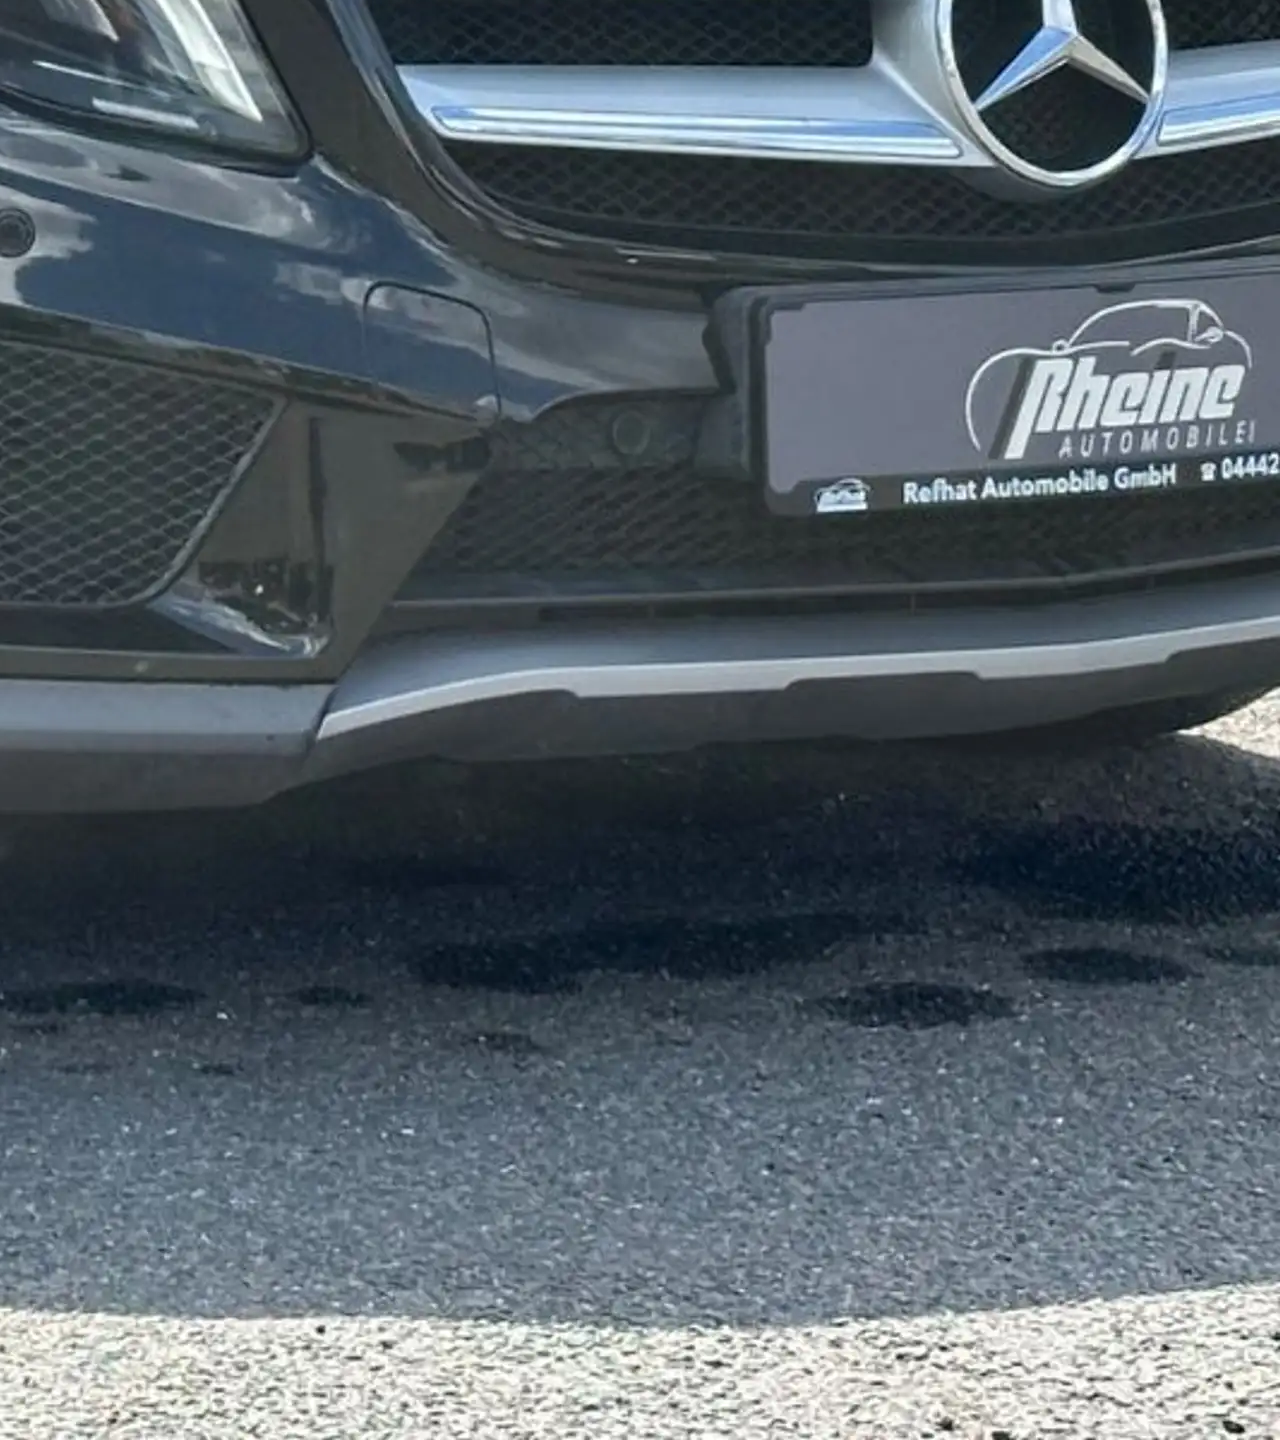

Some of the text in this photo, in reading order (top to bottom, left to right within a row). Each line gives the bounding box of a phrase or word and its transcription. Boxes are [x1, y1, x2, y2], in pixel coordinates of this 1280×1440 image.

[1003, 356, 1246, 460] Rheine
[902, 477, 977, 505] Refhat
[979, 467, 1109, 500] Automobile
[1113, 461, 1178, 490] GmbH
[1220, 451, 1280, 481] 04442
